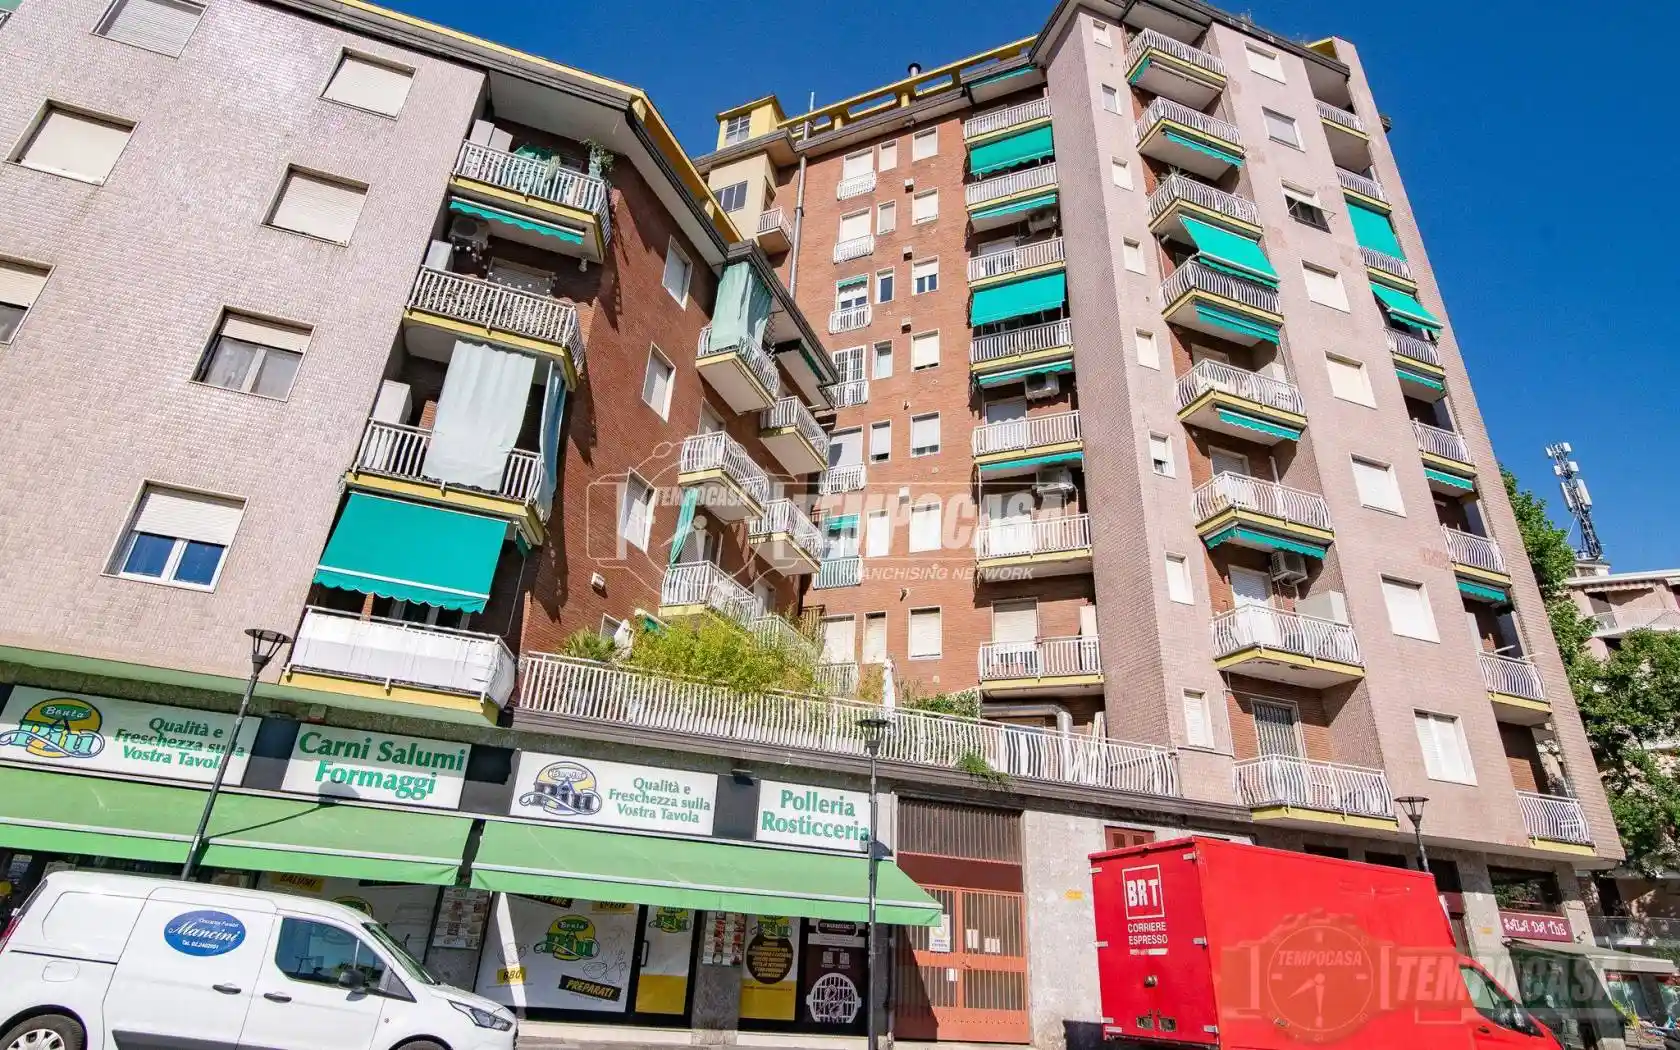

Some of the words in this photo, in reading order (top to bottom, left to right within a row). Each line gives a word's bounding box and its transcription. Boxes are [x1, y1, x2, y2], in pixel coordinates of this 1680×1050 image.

[150, 718, 209, 737] Qualità
[213, 728, 224, 738] e
[113, 728, 203, 751] Freschezza
[208, 739, 245, 757] sula
[299, 731, 372, 760] Carni
[376, 740, 466, 771] Salumi
[123, 745, 171, 764] Vostra
[178, 751, 221, 769] Tavol
[314, 759, 438, 800] Formaggi
[633, 777, 680, 795] Qualità
[684, 786, 691, 795] e
[609, 788, 677, 808] Freschezza
[680, 796, 711, 811] sulla
[780, 789, 856, 817] Polleria
[617, 803, 656, 819] Vostra
[661, 808, 700, 824] Tavola
[761, 810, 870, 841] Rosticceria
[1126, 878, 1159, 907] BRT
[168, 920, 241, 942] Mancini
[1127, 922, 1167, 933] CORRIERE
[1128, 934, 1168, 945] ESPRESSO
[566, 980, 615, 998] PREPARATI
